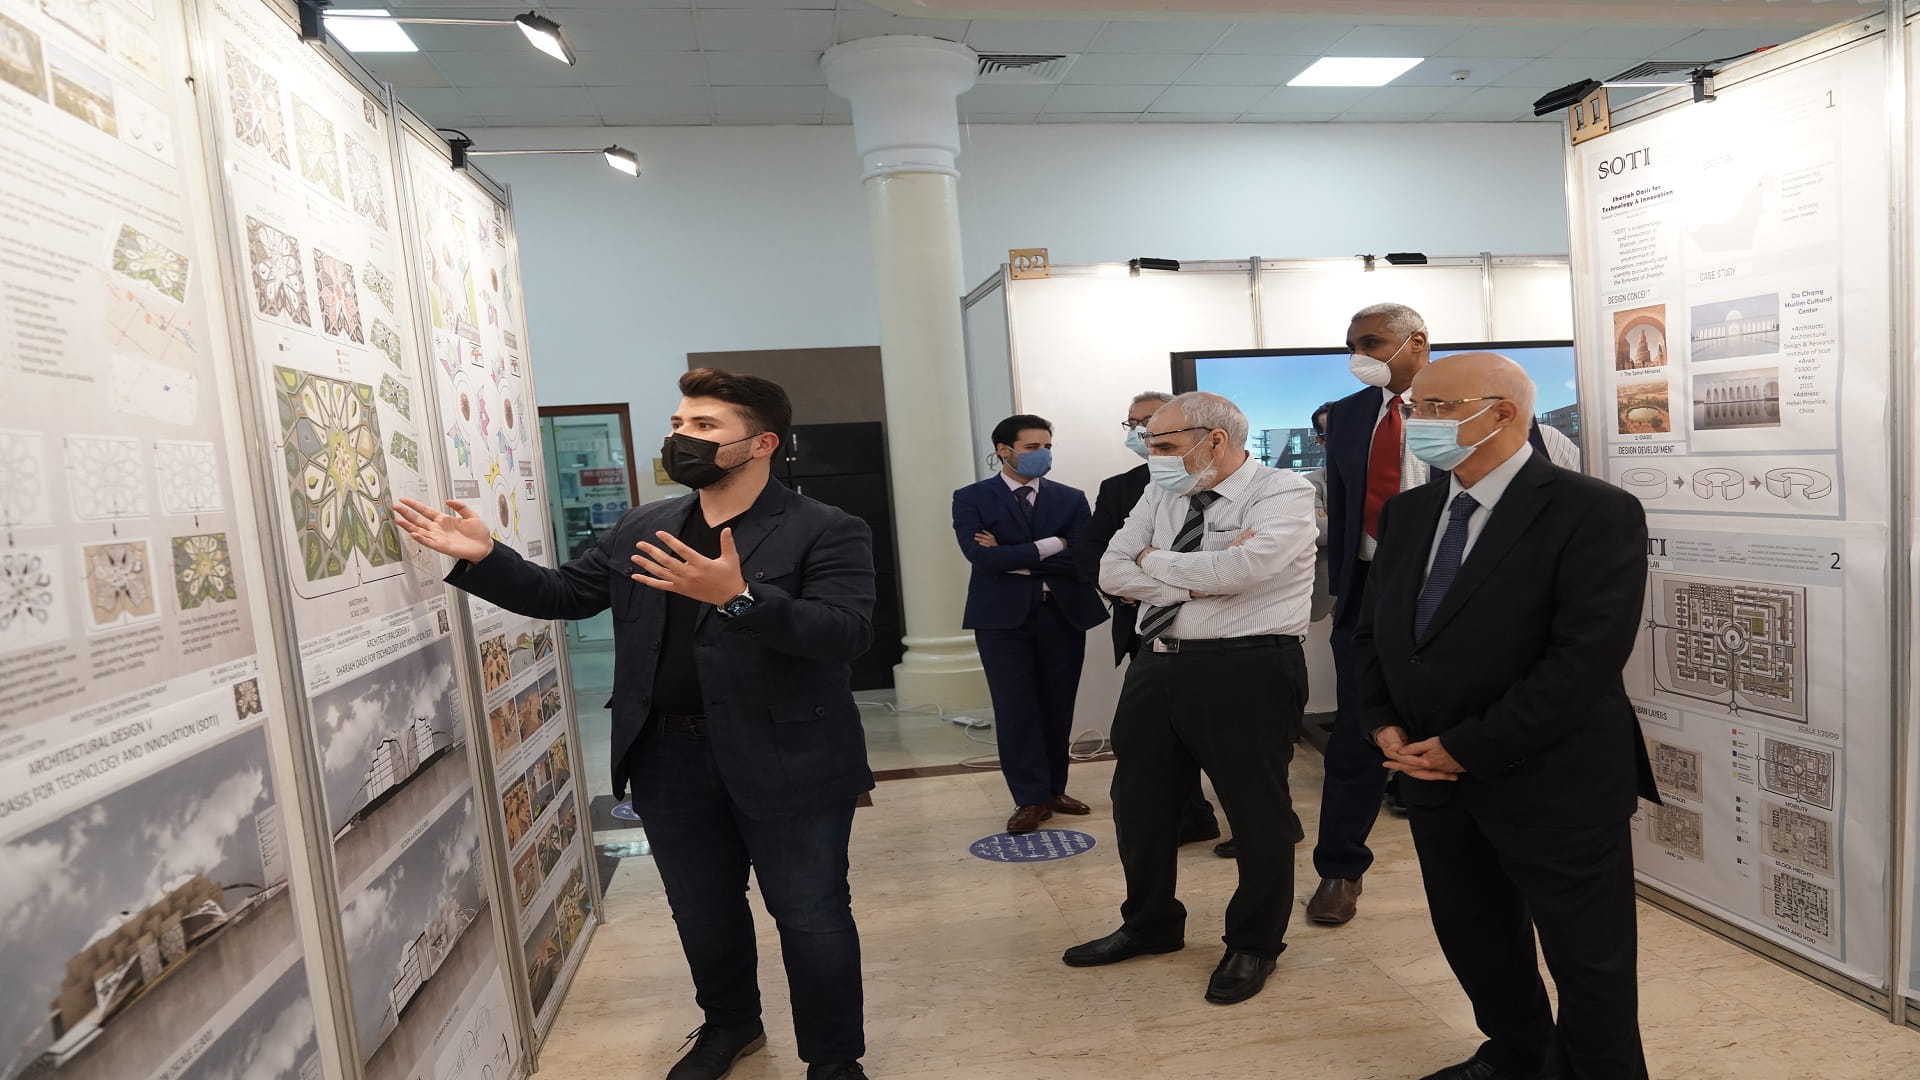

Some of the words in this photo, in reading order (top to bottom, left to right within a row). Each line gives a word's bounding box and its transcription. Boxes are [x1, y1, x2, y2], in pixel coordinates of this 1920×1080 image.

[1824, 89, 1836, 110] 1
[1597, 146, 1652, 180] SOTI
[1635, 187, 1651, 196] Oasis
[1602, 200, 1633, 213] Technology
[1640, 189, 1674, 203] Innovation
[1699, 271, 1715, 282] CASE
[1716, 266, 1736, 279] STUDY
[1608, 295, 1627, 305] DESIGN
[1801, 289, 1824, 298] Chang
[1784, 300, 1806, 308] Muslim
[1806, 296, 1832, 305] Cultural
[1798, 307, 1818, 315] Center
[1790, 331, 1827, 340] Architectural
[1783, 342, 1802, 350] Design
[1809, 338, 1835, 347] Research
[1618, 446, 1637, 455] DESIGN
[1638, 444, 1675, 454] DEVELOPMENT
[1648, 538, 1668, 556] TI
[1830, 552, 1841, 570] 2
[356, 655, 368, 670] OASIS
[367, 652, 376, 663] FOR
[1648, 708, 1668, 721] LAYERS
[28, 734, 110, 777] ARCHITECTURAL
[110, 721, 146, 746] DESIGN
[146, 717, 153, 731] V
[33, 781, 56, 804] FOR
[56, 754, 120, 792] TECHNOLOGY
[122, 745, 144, 763] AND
[144, 725, 196, 756] INNOVATION
[1784, 801, 1808, 812] MOBILITY
[1775, 860, 1792, 870] BLOCK
[1777, 922, 1790, 932] MASS
[1803, 934, 1816, 945] VOID
